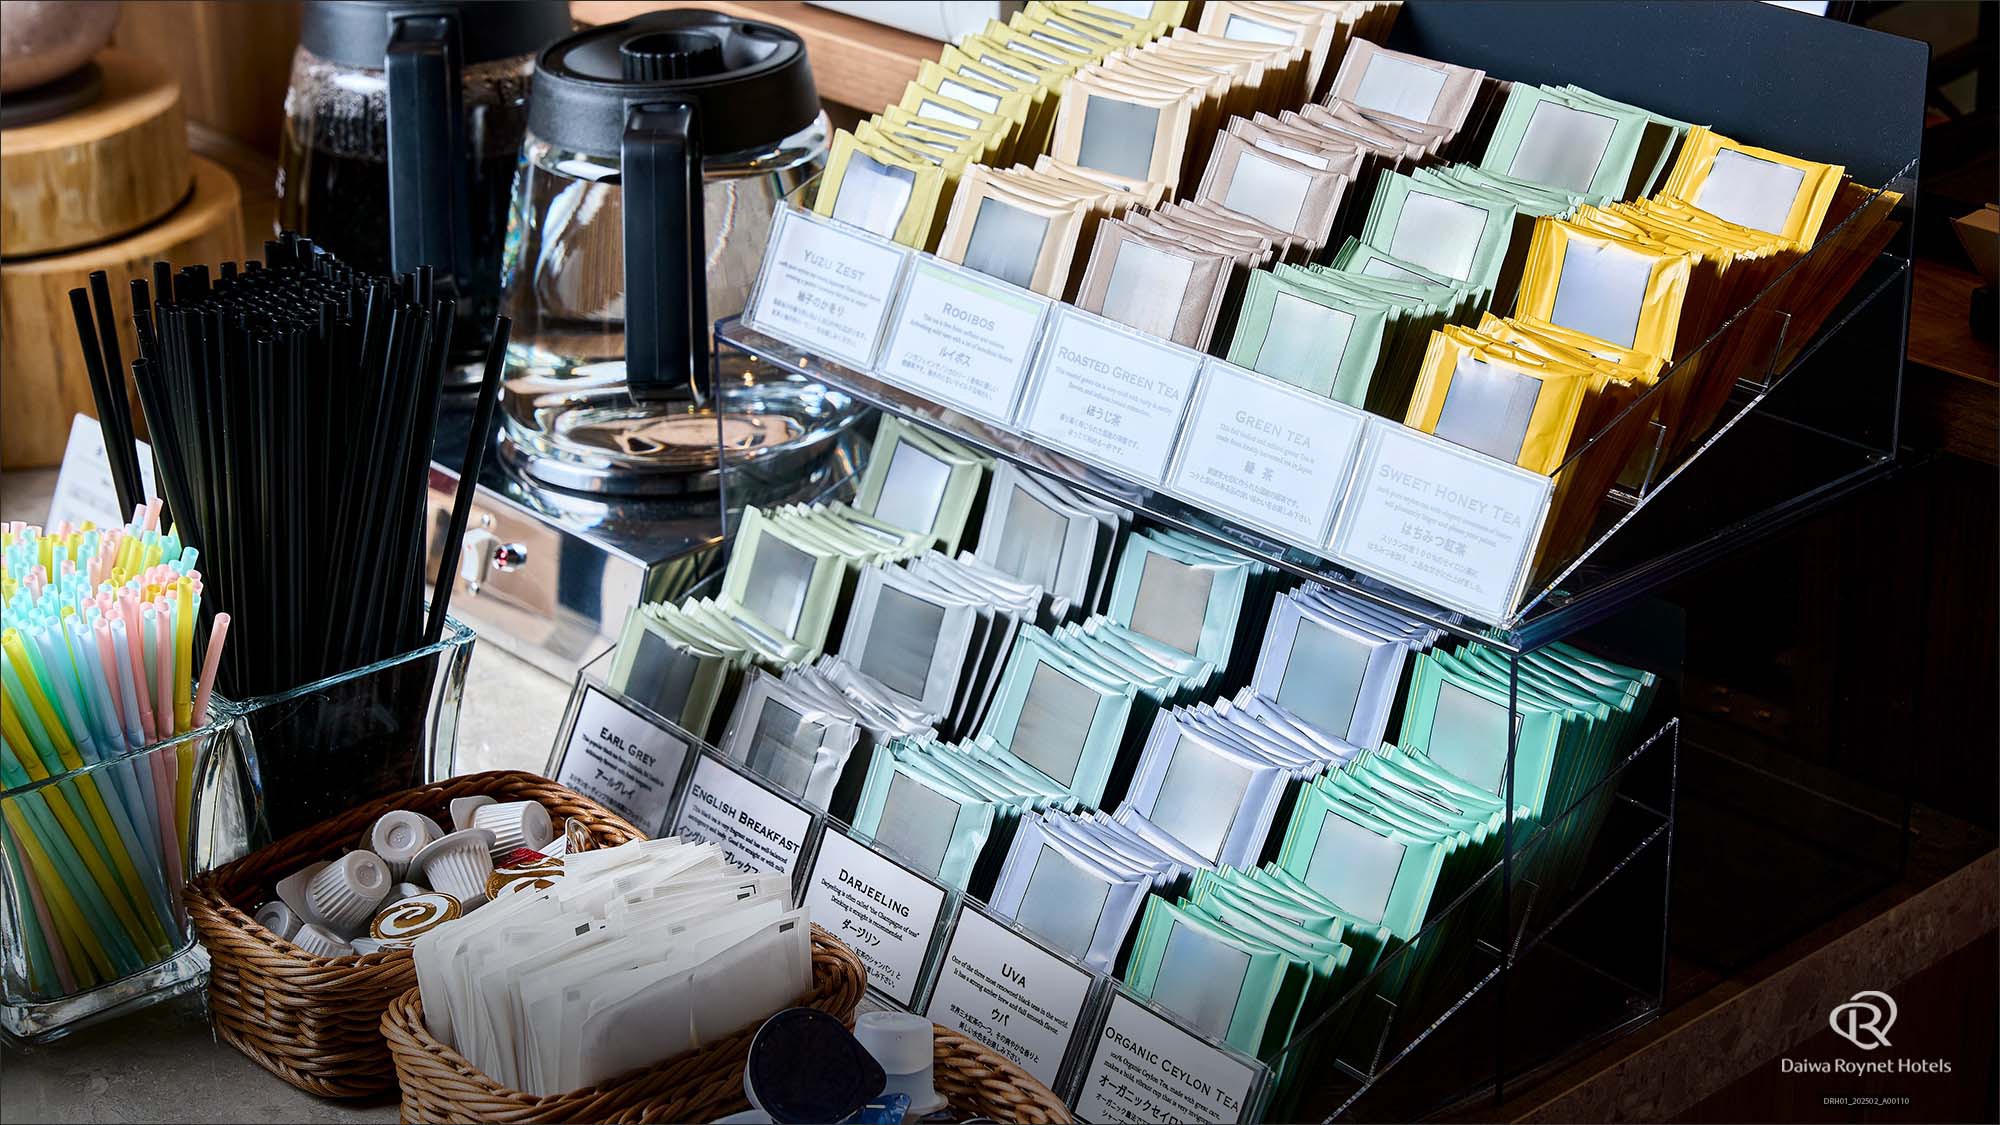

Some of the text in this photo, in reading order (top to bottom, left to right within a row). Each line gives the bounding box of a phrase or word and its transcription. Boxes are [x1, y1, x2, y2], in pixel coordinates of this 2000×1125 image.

[804, 249, 832, 269] YUZU
[835, 262, 865, 281] ZEST
[942, 302, 995, 331] ROOIBOS
[938, 346, 971, 367] ルイボス
[1057, 346, 1110, 374] ROASTED
[1112, 366, 1154, 390] GREEN
[1157, 381, 1179, 400] TEA
[1086, 404, 1122, 427] ほうじ茶
[1235, 410, 1311, 448] GREEN TEA
[1261, 467, 1274, 482] 茶
[1378, 464, 1432, 492] SWEET
[1434, 484, 1488, 514] HONEY
[1493, 505, 1521, 528] TEA
[1400, 521, 1468, 557] はちみつ紅茶
[600, 727, 656, 767] EARL GREY
[595, 768, 636, 800] アールグレイ
[691, 784, 737, 818] ENGLISH
[738, 811, 800, 854] BREAKFAST
[821, 878, 841, 896] Darjeeling
[845, 894, 856, 903] often
[856, 900, 869, 910] called
[877, 911, 903, 930] Champagne
[831, 895, 849, 911] Drinking
[852, 909, 868, 921] straight
[838, 869, 910, 917] DARJEELING
[842, 918, 880, 946] ダージリン
[951, 955, 961, 965] One
[966, 964, 974, 973] the
[973, 969, 985, 979] three
[985, 976, 997, 986] most
[996, 983, 1018, 999] renowned
[1018, 994, 1031, 1006] black
[1030, 1003, 1040, 1012] teas
[1040, 1007, 1046, 1015] in
[1045, 1012, 1054, 1020] the
[1001, 963, 1026, 988] UVA
[958, 970, 966, 979] has
[969, 978, 983, 991] strong
[983, 987, 998, 998] amber
[997, 994, 1009, 1005] brew
[1008, 1002, 1018, 1010] and
[1017, 1006, 1027, 1016] full
[1026, 1013, 1044, 1026] smooth
[991, 1008, 1010, 1027] ウパ
[1103, 1060, 1119, 1073] makes
[1135, 1079, 1152, 1092] vibrant
[1152, 1089, 1161, 1099] cup
[1161, 1094, 1172, 1104] that
[1177, 1103, 1187, 1114] very
[1105, 1026, 1238, 1112] ORGANIC CEYLON TEA
[1122, 1058, 1141, 1074] Organic
[1141, 1069, 1159, 1084] Ceylon
[1159, 1078, 1169, 1090] Tea,
[1169, 1087, 1183, 1098] made
[1184, 1095, 1195, 1105] with
[1194, 1102, 1208, 1112] great
[1099, 1074, 1183, 1124] オーガニックセイロ
